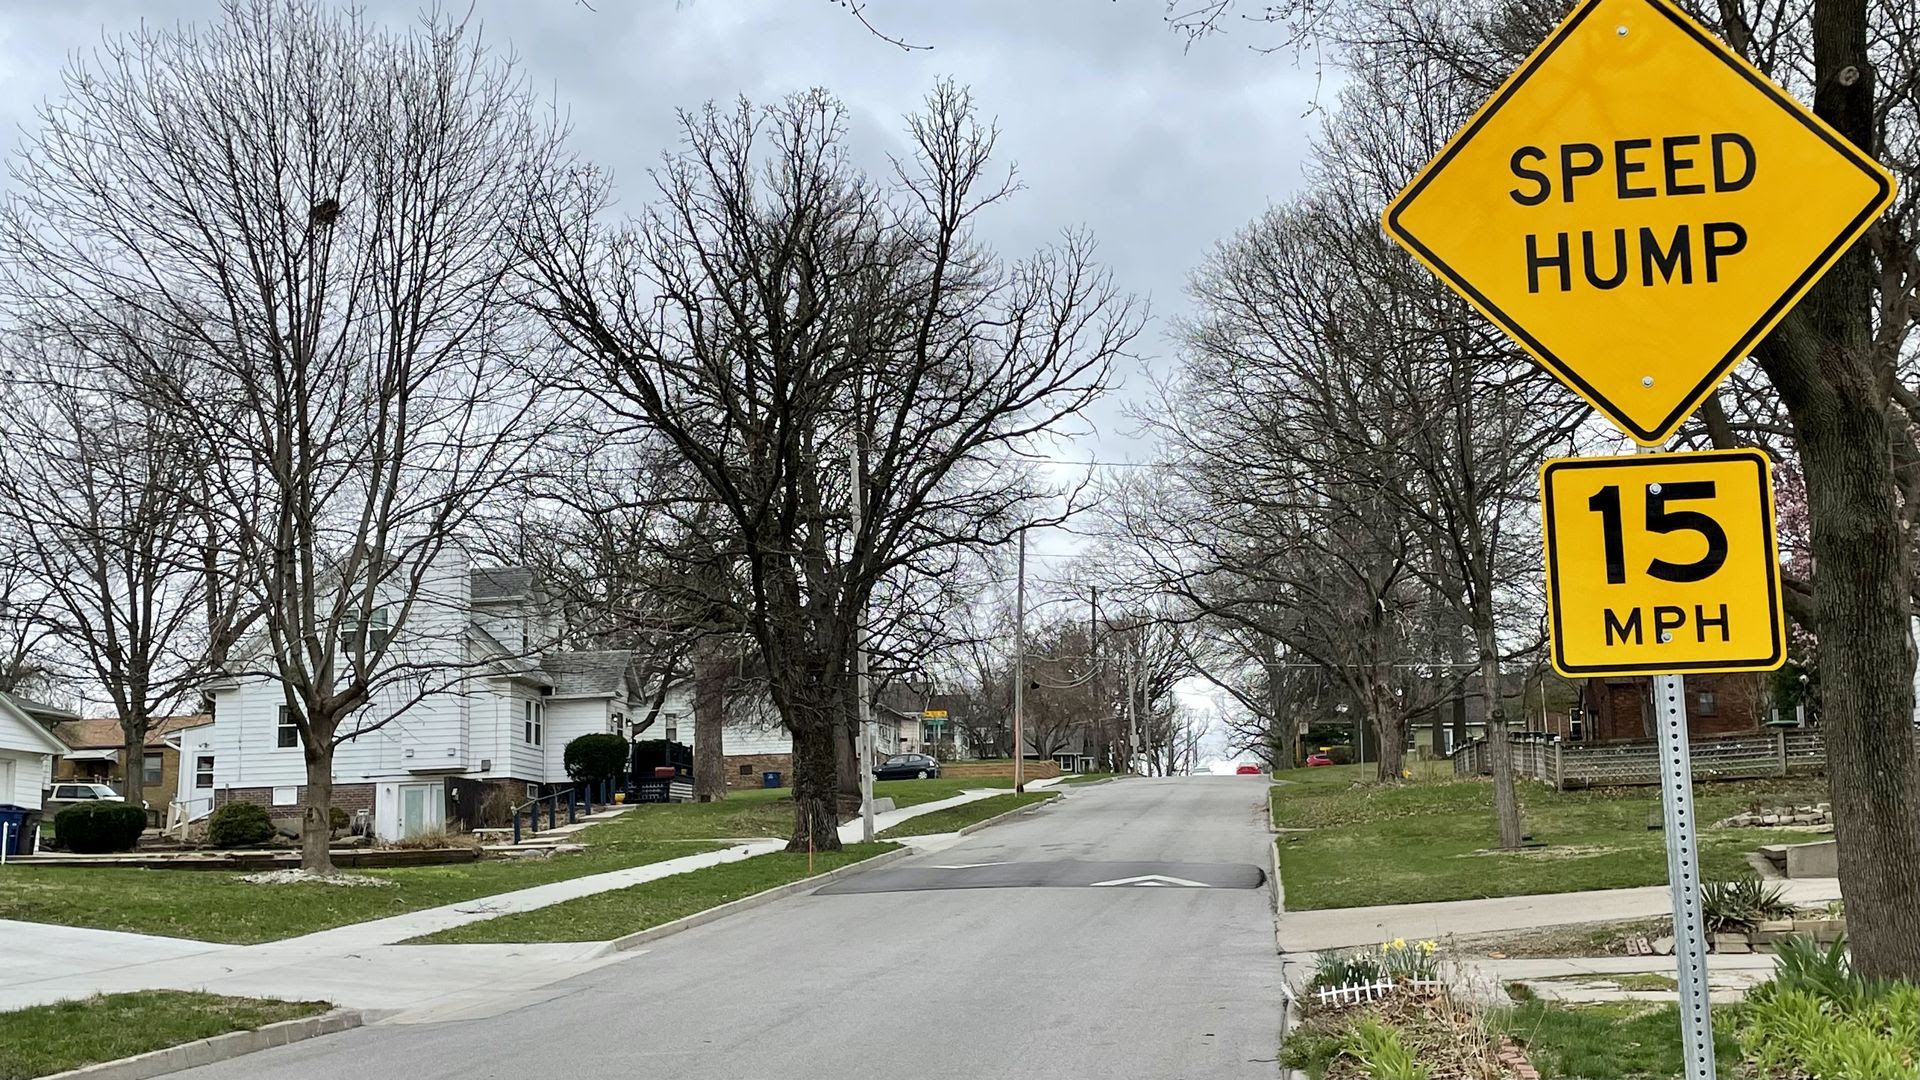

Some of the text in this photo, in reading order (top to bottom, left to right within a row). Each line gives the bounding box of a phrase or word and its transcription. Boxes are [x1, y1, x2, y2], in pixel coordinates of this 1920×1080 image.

[1509, 132, 1757, 207] SPEED
[1525, 221, 1748, 294] HUMP
[1588, 480, 1729, 585] 15
[1603, 603, 1730, 646] MPH
